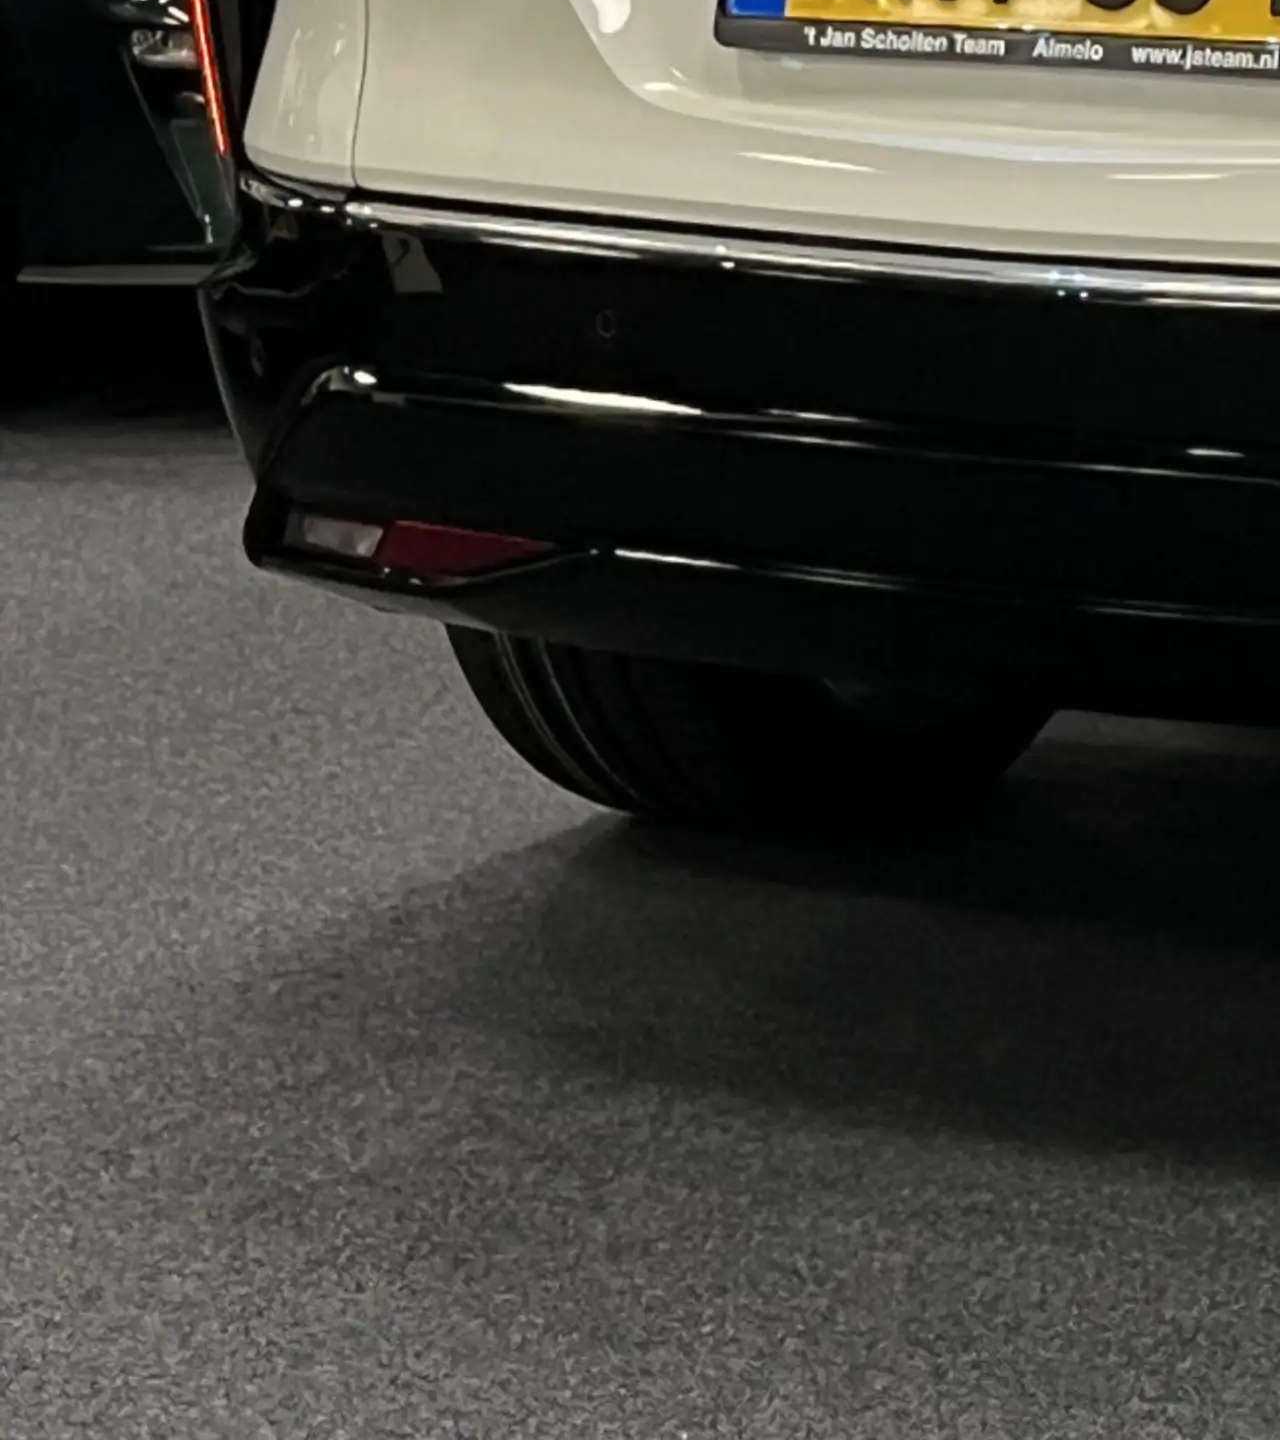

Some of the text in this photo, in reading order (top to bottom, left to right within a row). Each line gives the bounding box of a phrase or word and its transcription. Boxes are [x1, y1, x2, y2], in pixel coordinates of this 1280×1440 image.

[820, 26, 856, 48] Jan
[860, 27, 948, 53] Scholten
[952, 33, 1006, 57] Team
[1032, 37, 1104, 61] Almelo
[1131, 44, 1280, 71] www.jsteam.nl
